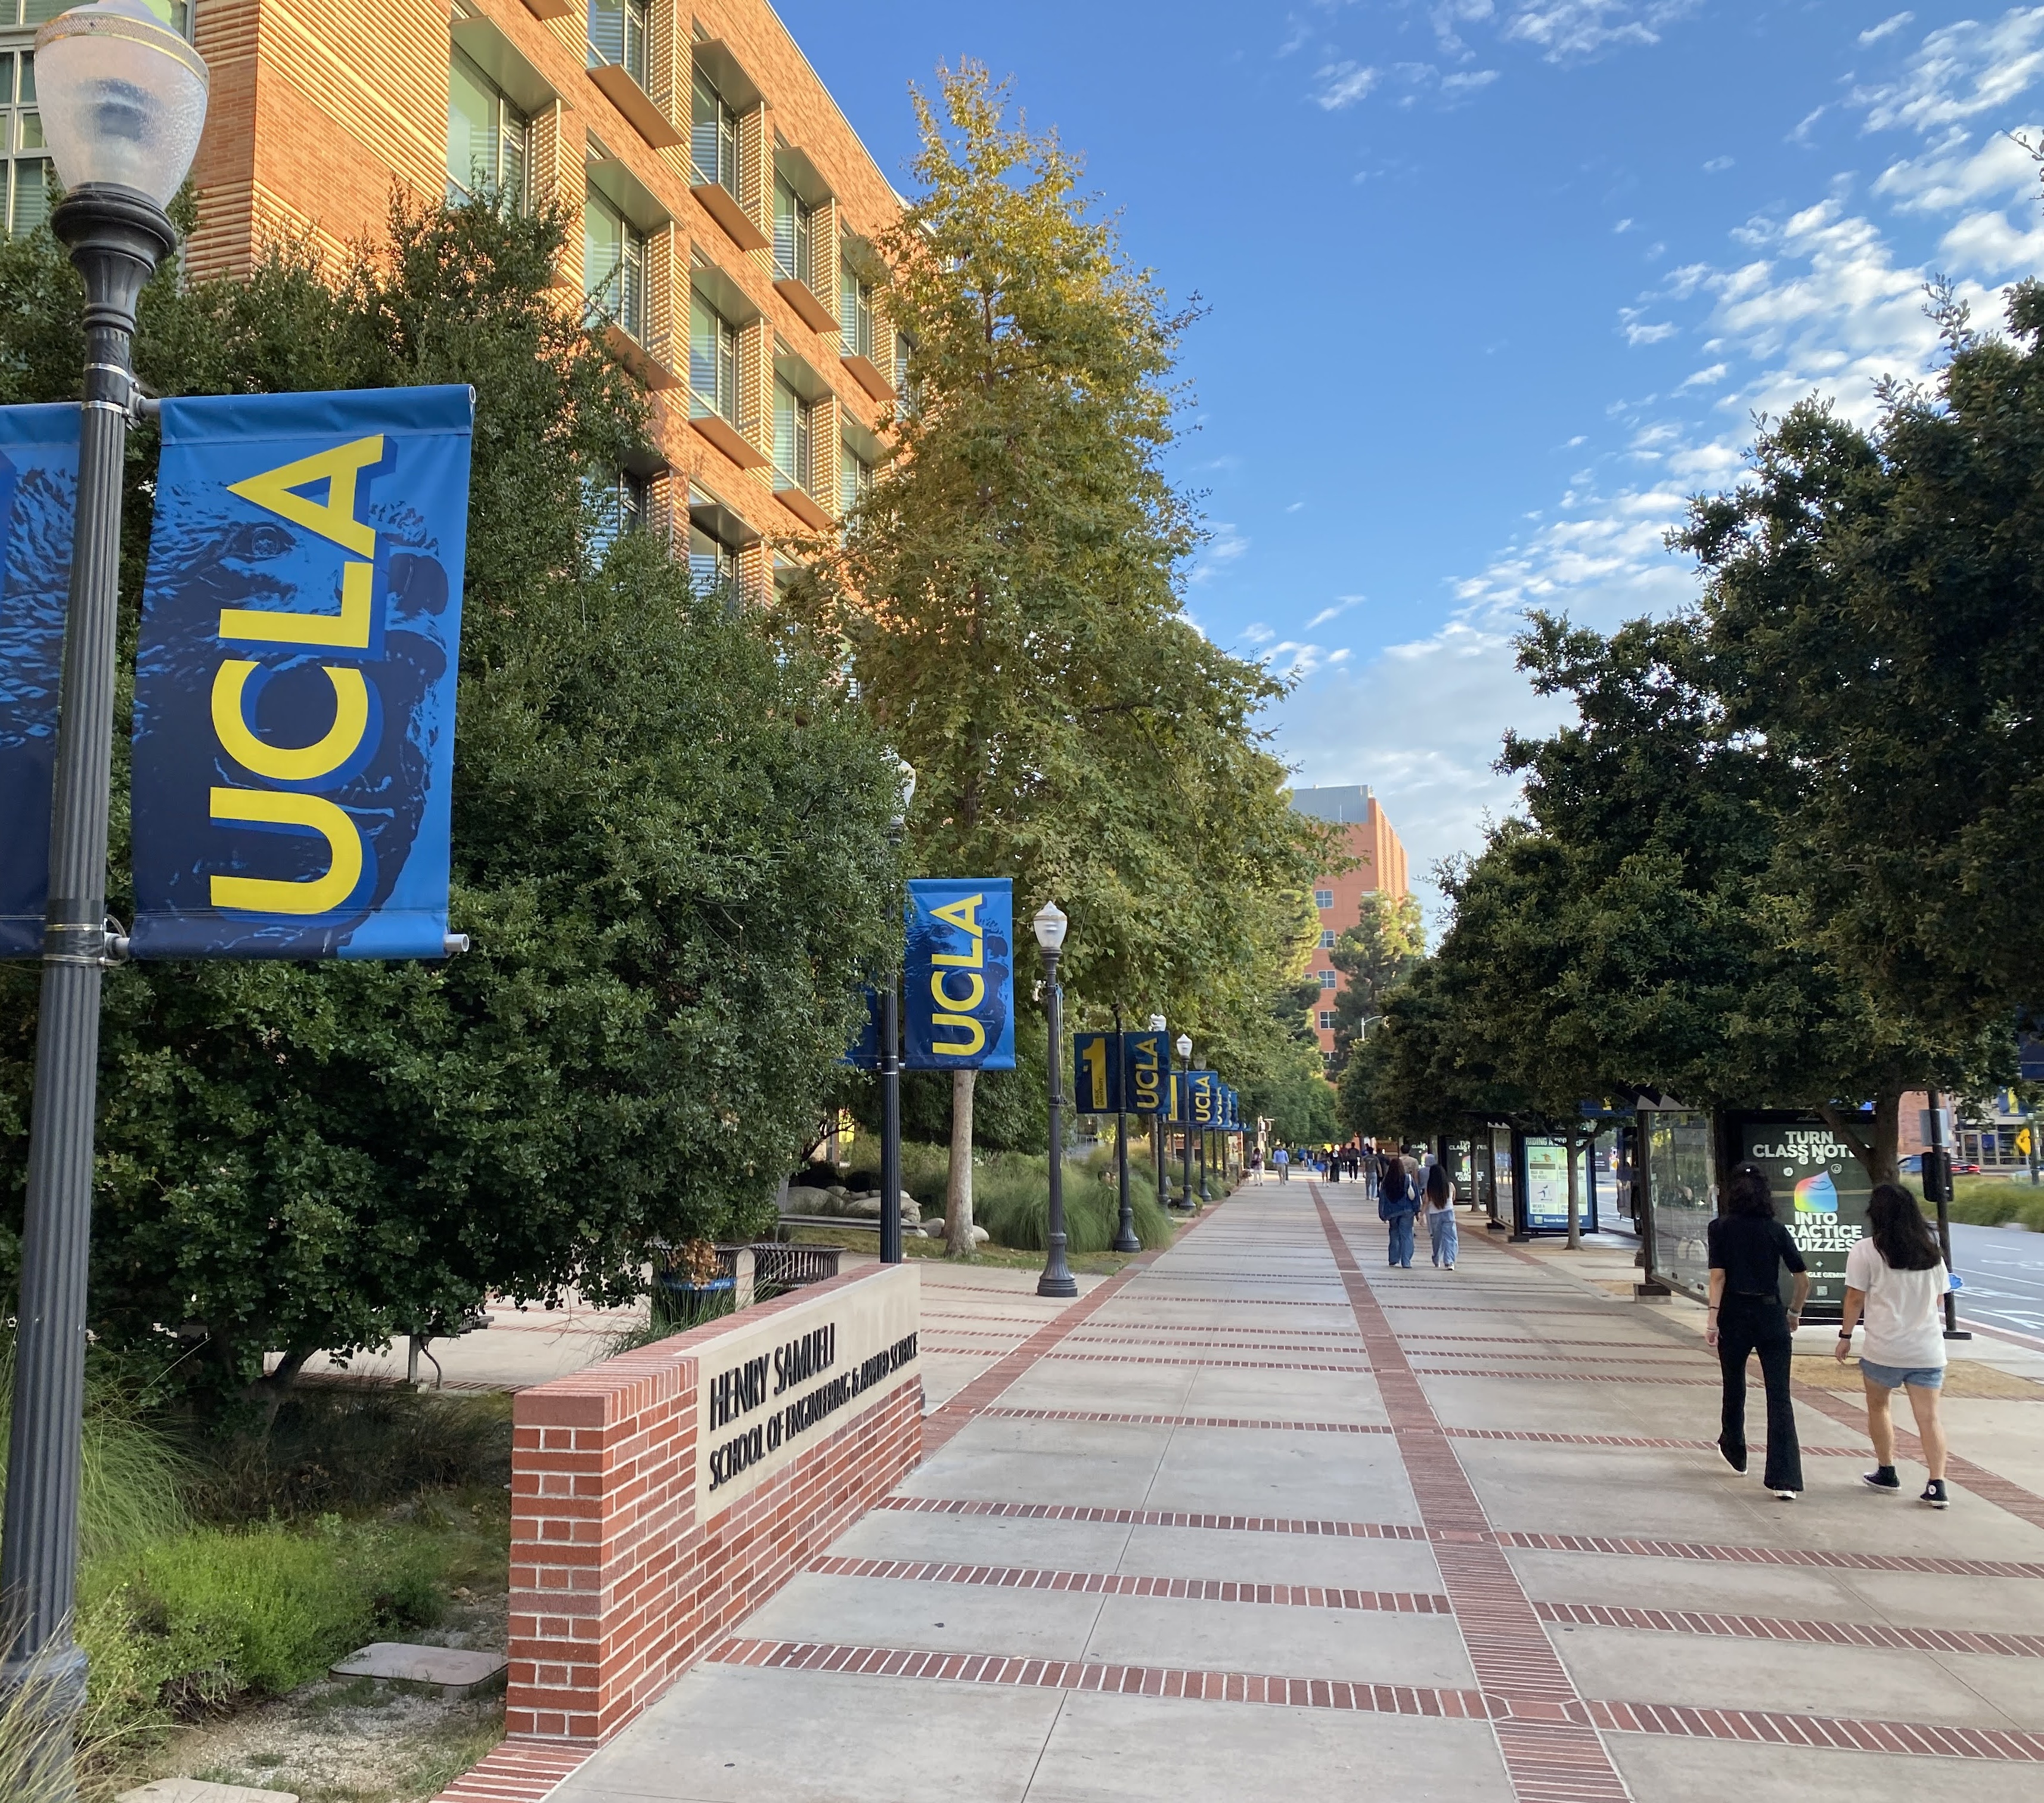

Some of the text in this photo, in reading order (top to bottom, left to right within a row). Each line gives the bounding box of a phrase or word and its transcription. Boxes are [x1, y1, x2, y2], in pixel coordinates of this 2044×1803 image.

[209, 433, 384, 915] UCLA
[929, 893, 985, 1056] UCLA
[1135, 1037, 1159, 1108] UCLA
[1195, 1076, 1211, 1122] UCLA
[1526, 1137, 1547, 1145] RIDING
[1753, 1144, 1870, 1158] CLASS NOT
[1785, 1131, 1834, 1144] TURN
[1785, 1224, 1863, 1238] RACTICE
[1794, 1211, 1838, 1225] INTO
[1794, 1238, 1856, 1252] UIZZES
[710, 1322, 835, 1432] HENRY SAMUELI
[709, 1331, 919, 1491] SCHOOL OF ENGINEERING & APPLIED SCIENCE
